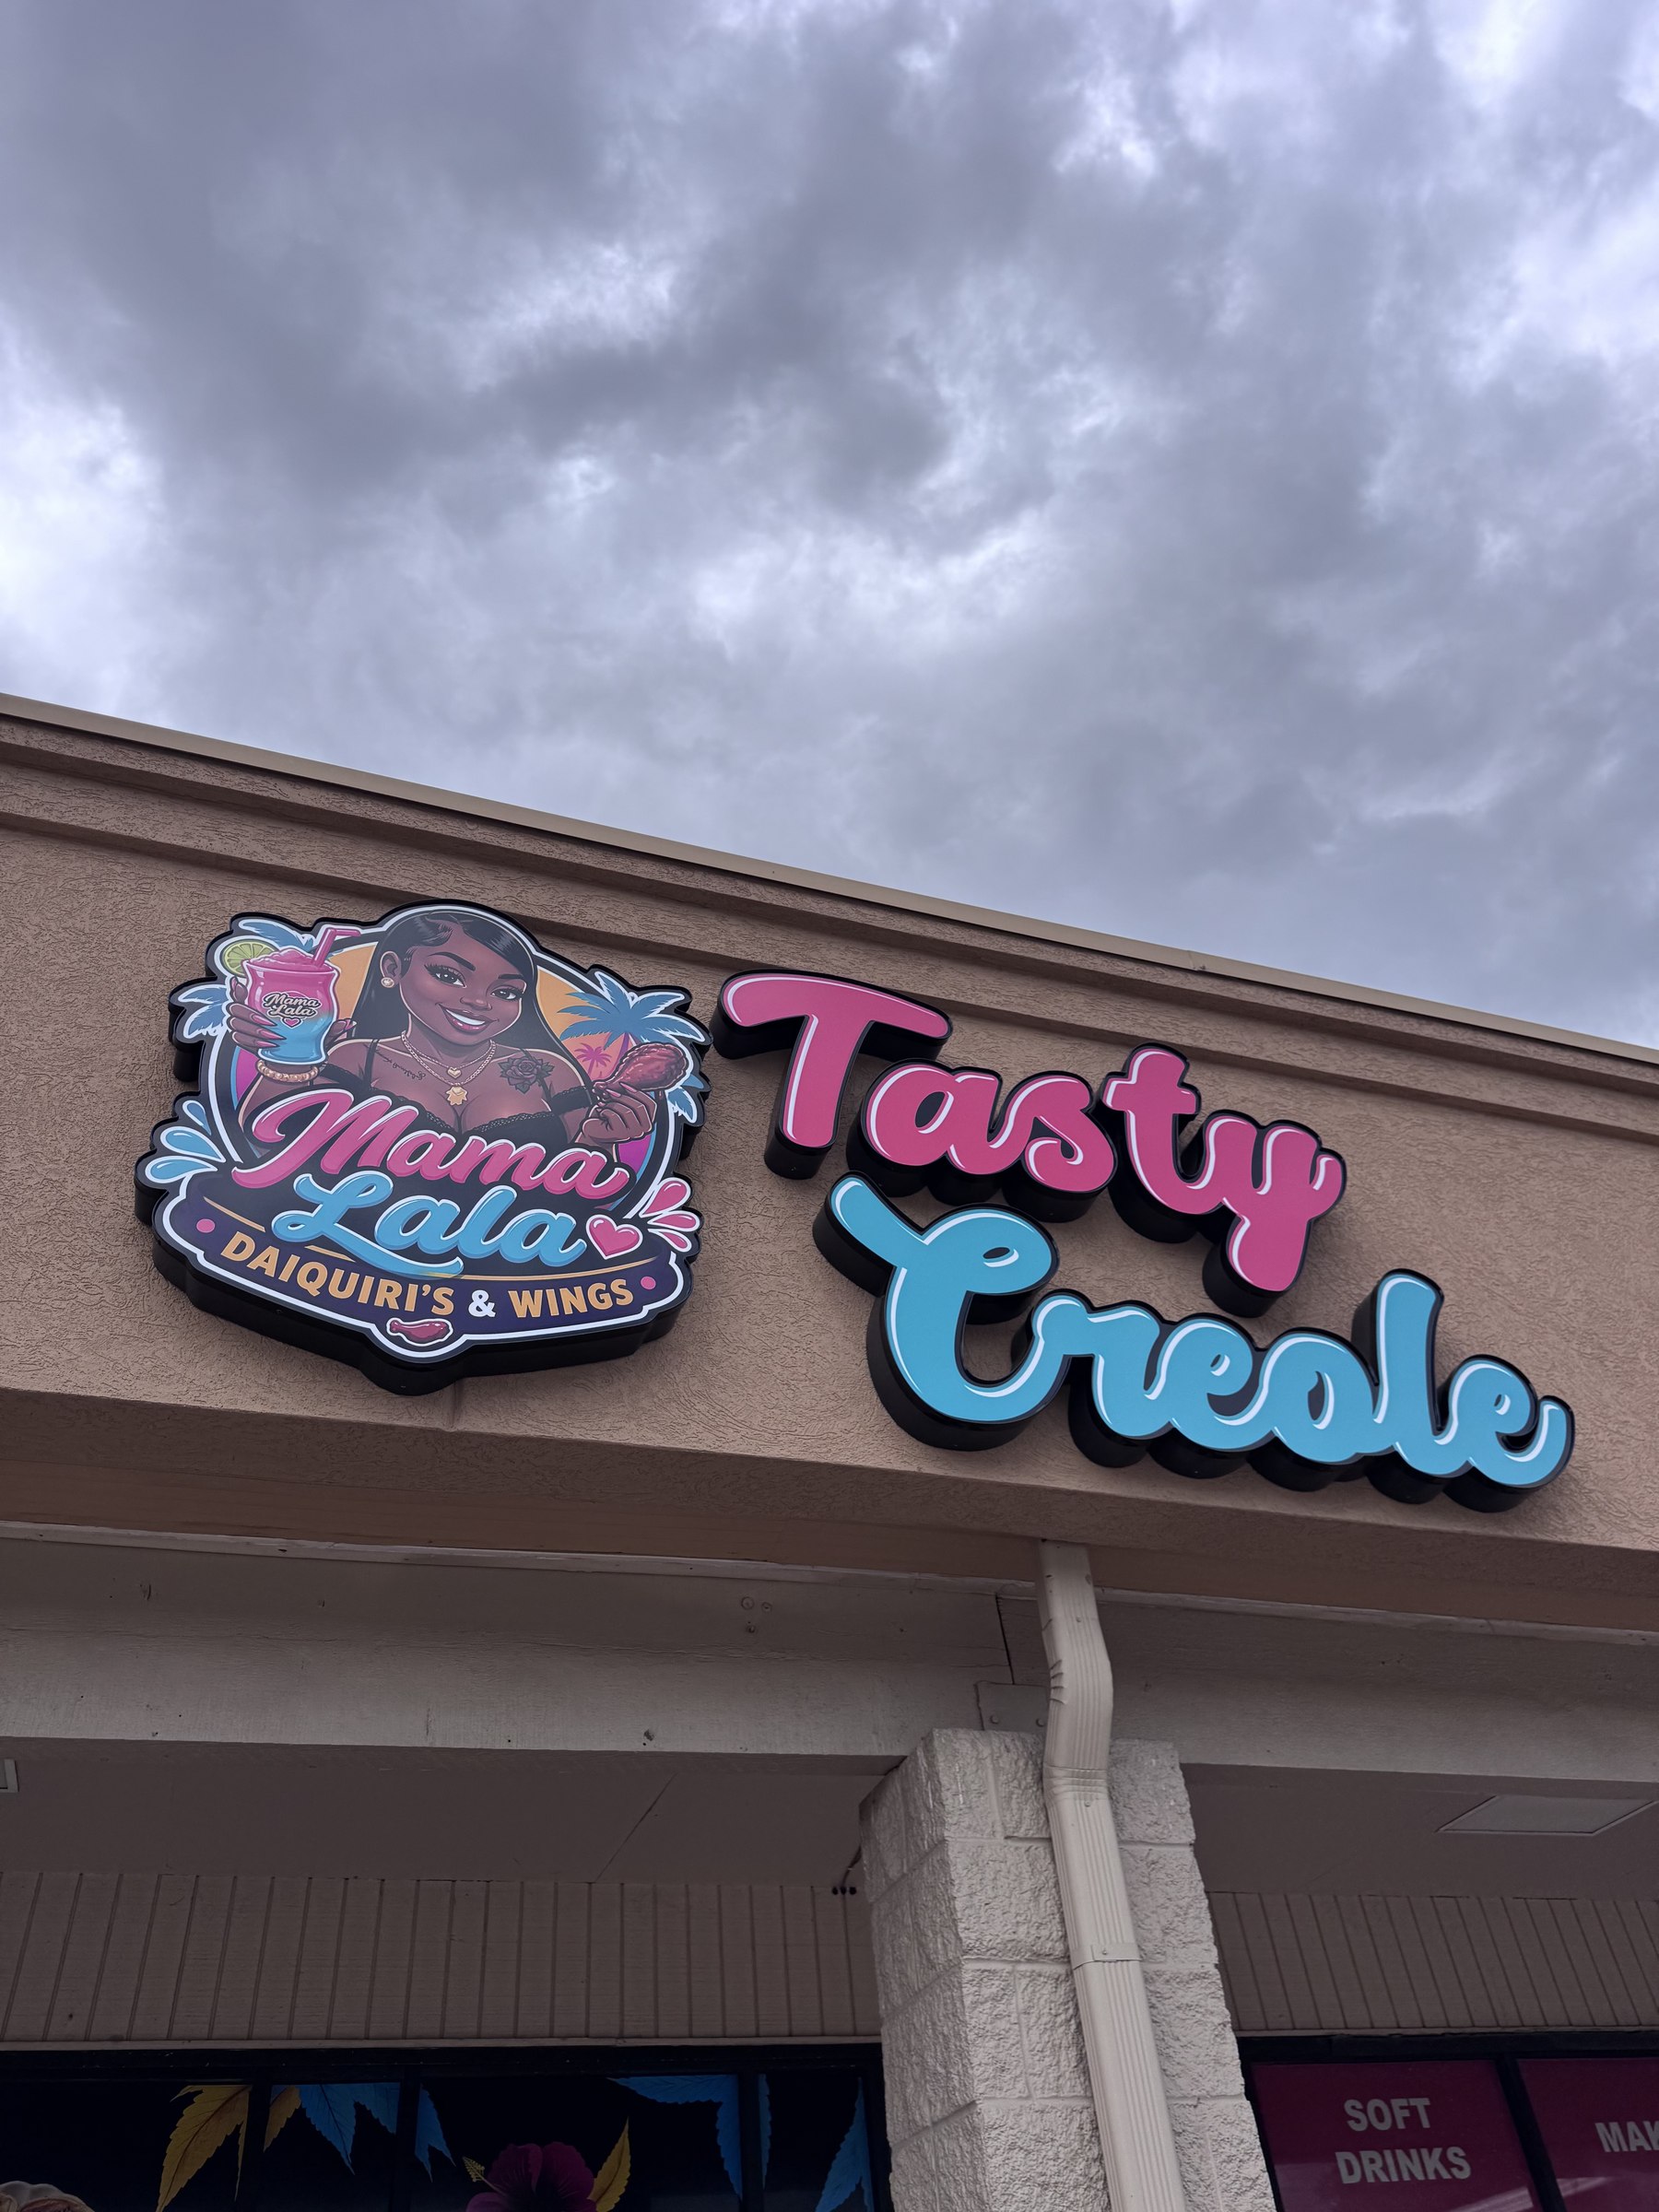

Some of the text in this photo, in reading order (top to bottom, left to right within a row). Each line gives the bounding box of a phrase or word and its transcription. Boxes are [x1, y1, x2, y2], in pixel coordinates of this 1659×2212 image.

[264, 993, 321, 1008] Mama
[269, 1004, 315, 1018] Lala
[231, 1088, 630, 1200] Mama
[722, 972, 1343, 1291] Tasty
[273, 1171, 587, 1277] Lala
[221, 1231, 635, 1319] DAIQUIRI'S & WINGS
[832, 1182, 1573, 1486] Creole
[1344, 2098, 1430, 2132] SOFT
[1335, 2147, 1471, 2184] DRINKS
